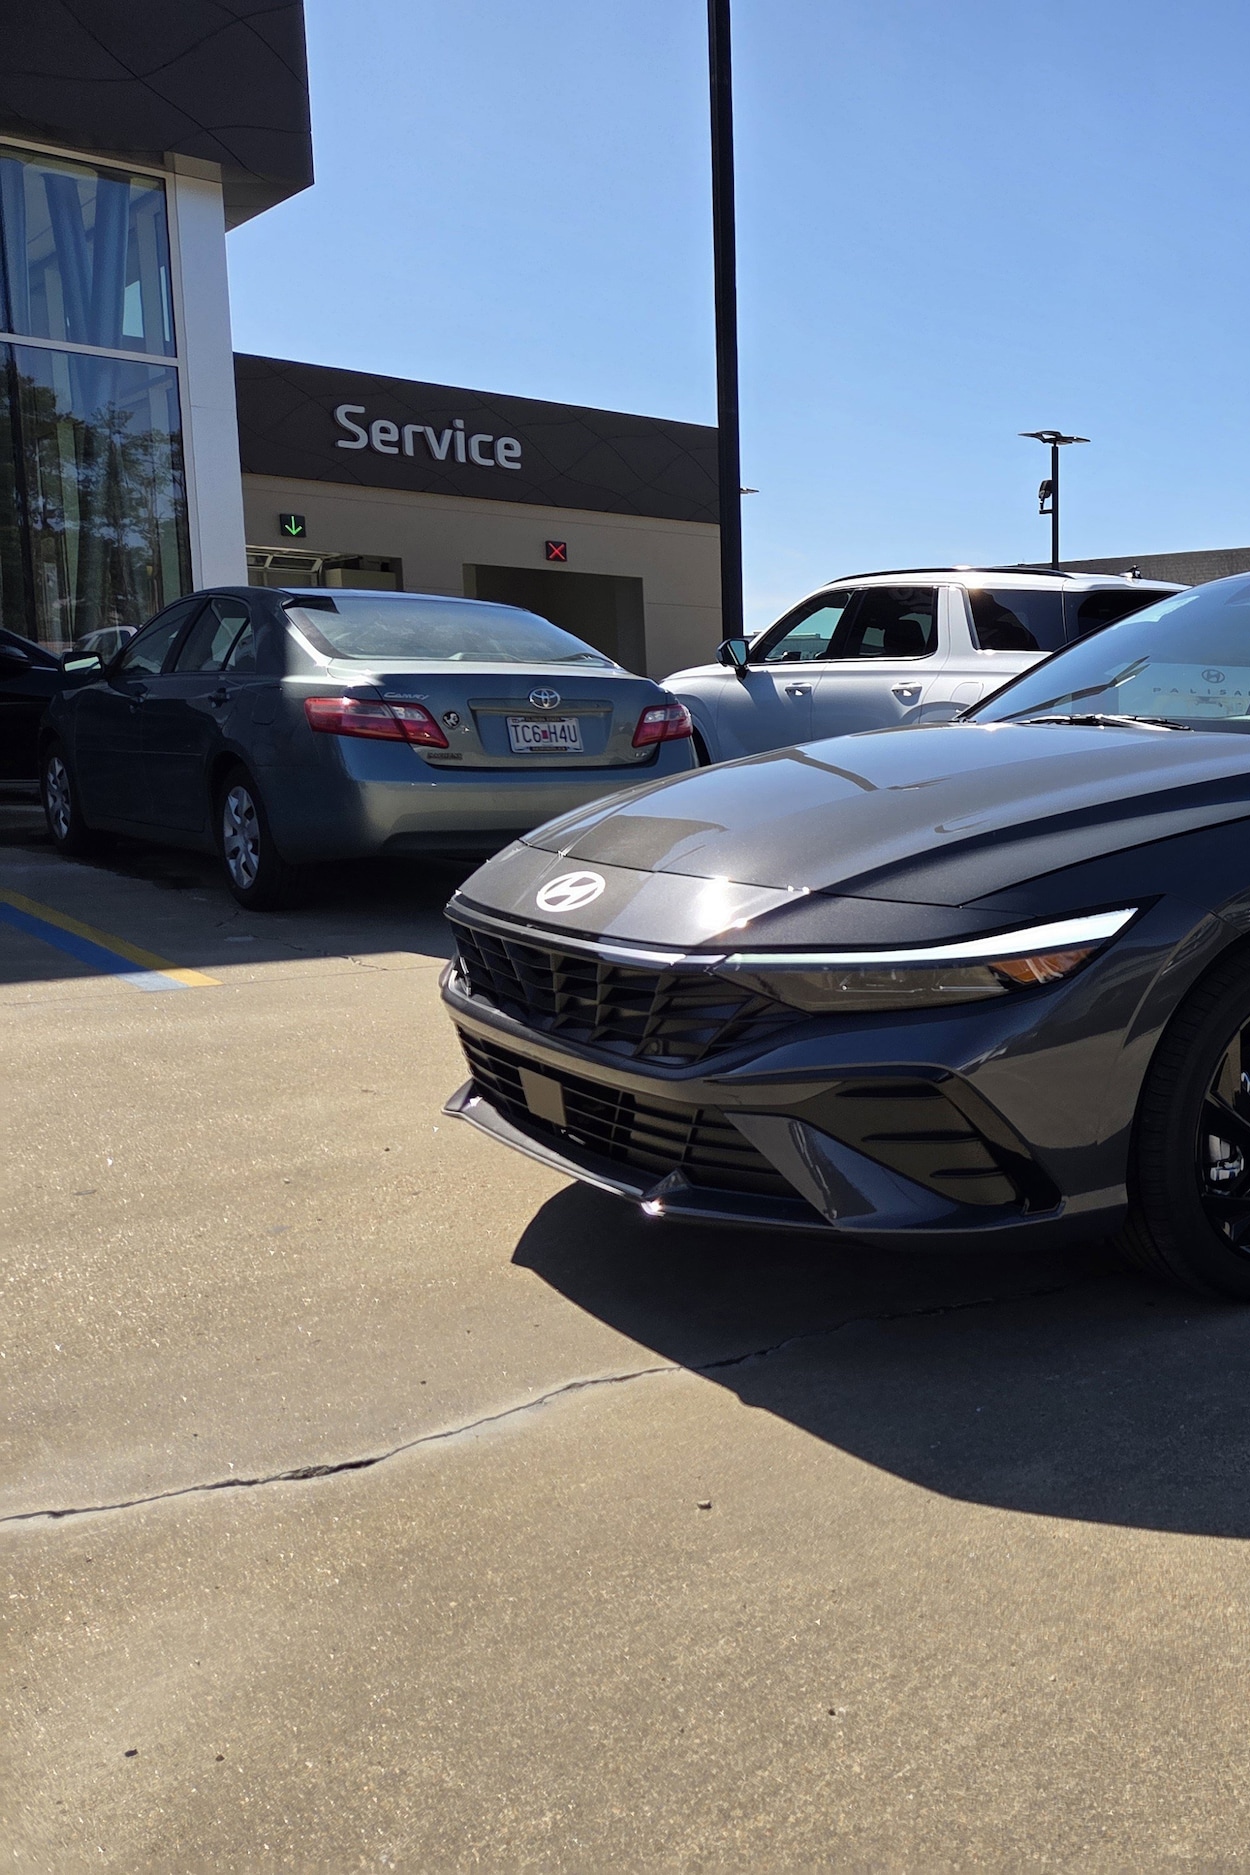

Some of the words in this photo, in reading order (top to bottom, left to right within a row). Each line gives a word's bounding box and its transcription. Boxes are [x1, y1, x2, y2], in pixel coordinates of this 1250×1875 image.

[334, 404, 522, 470] Service
[511, 724, 541, 743] TC6
[548, 724, 578, 743] H4U
